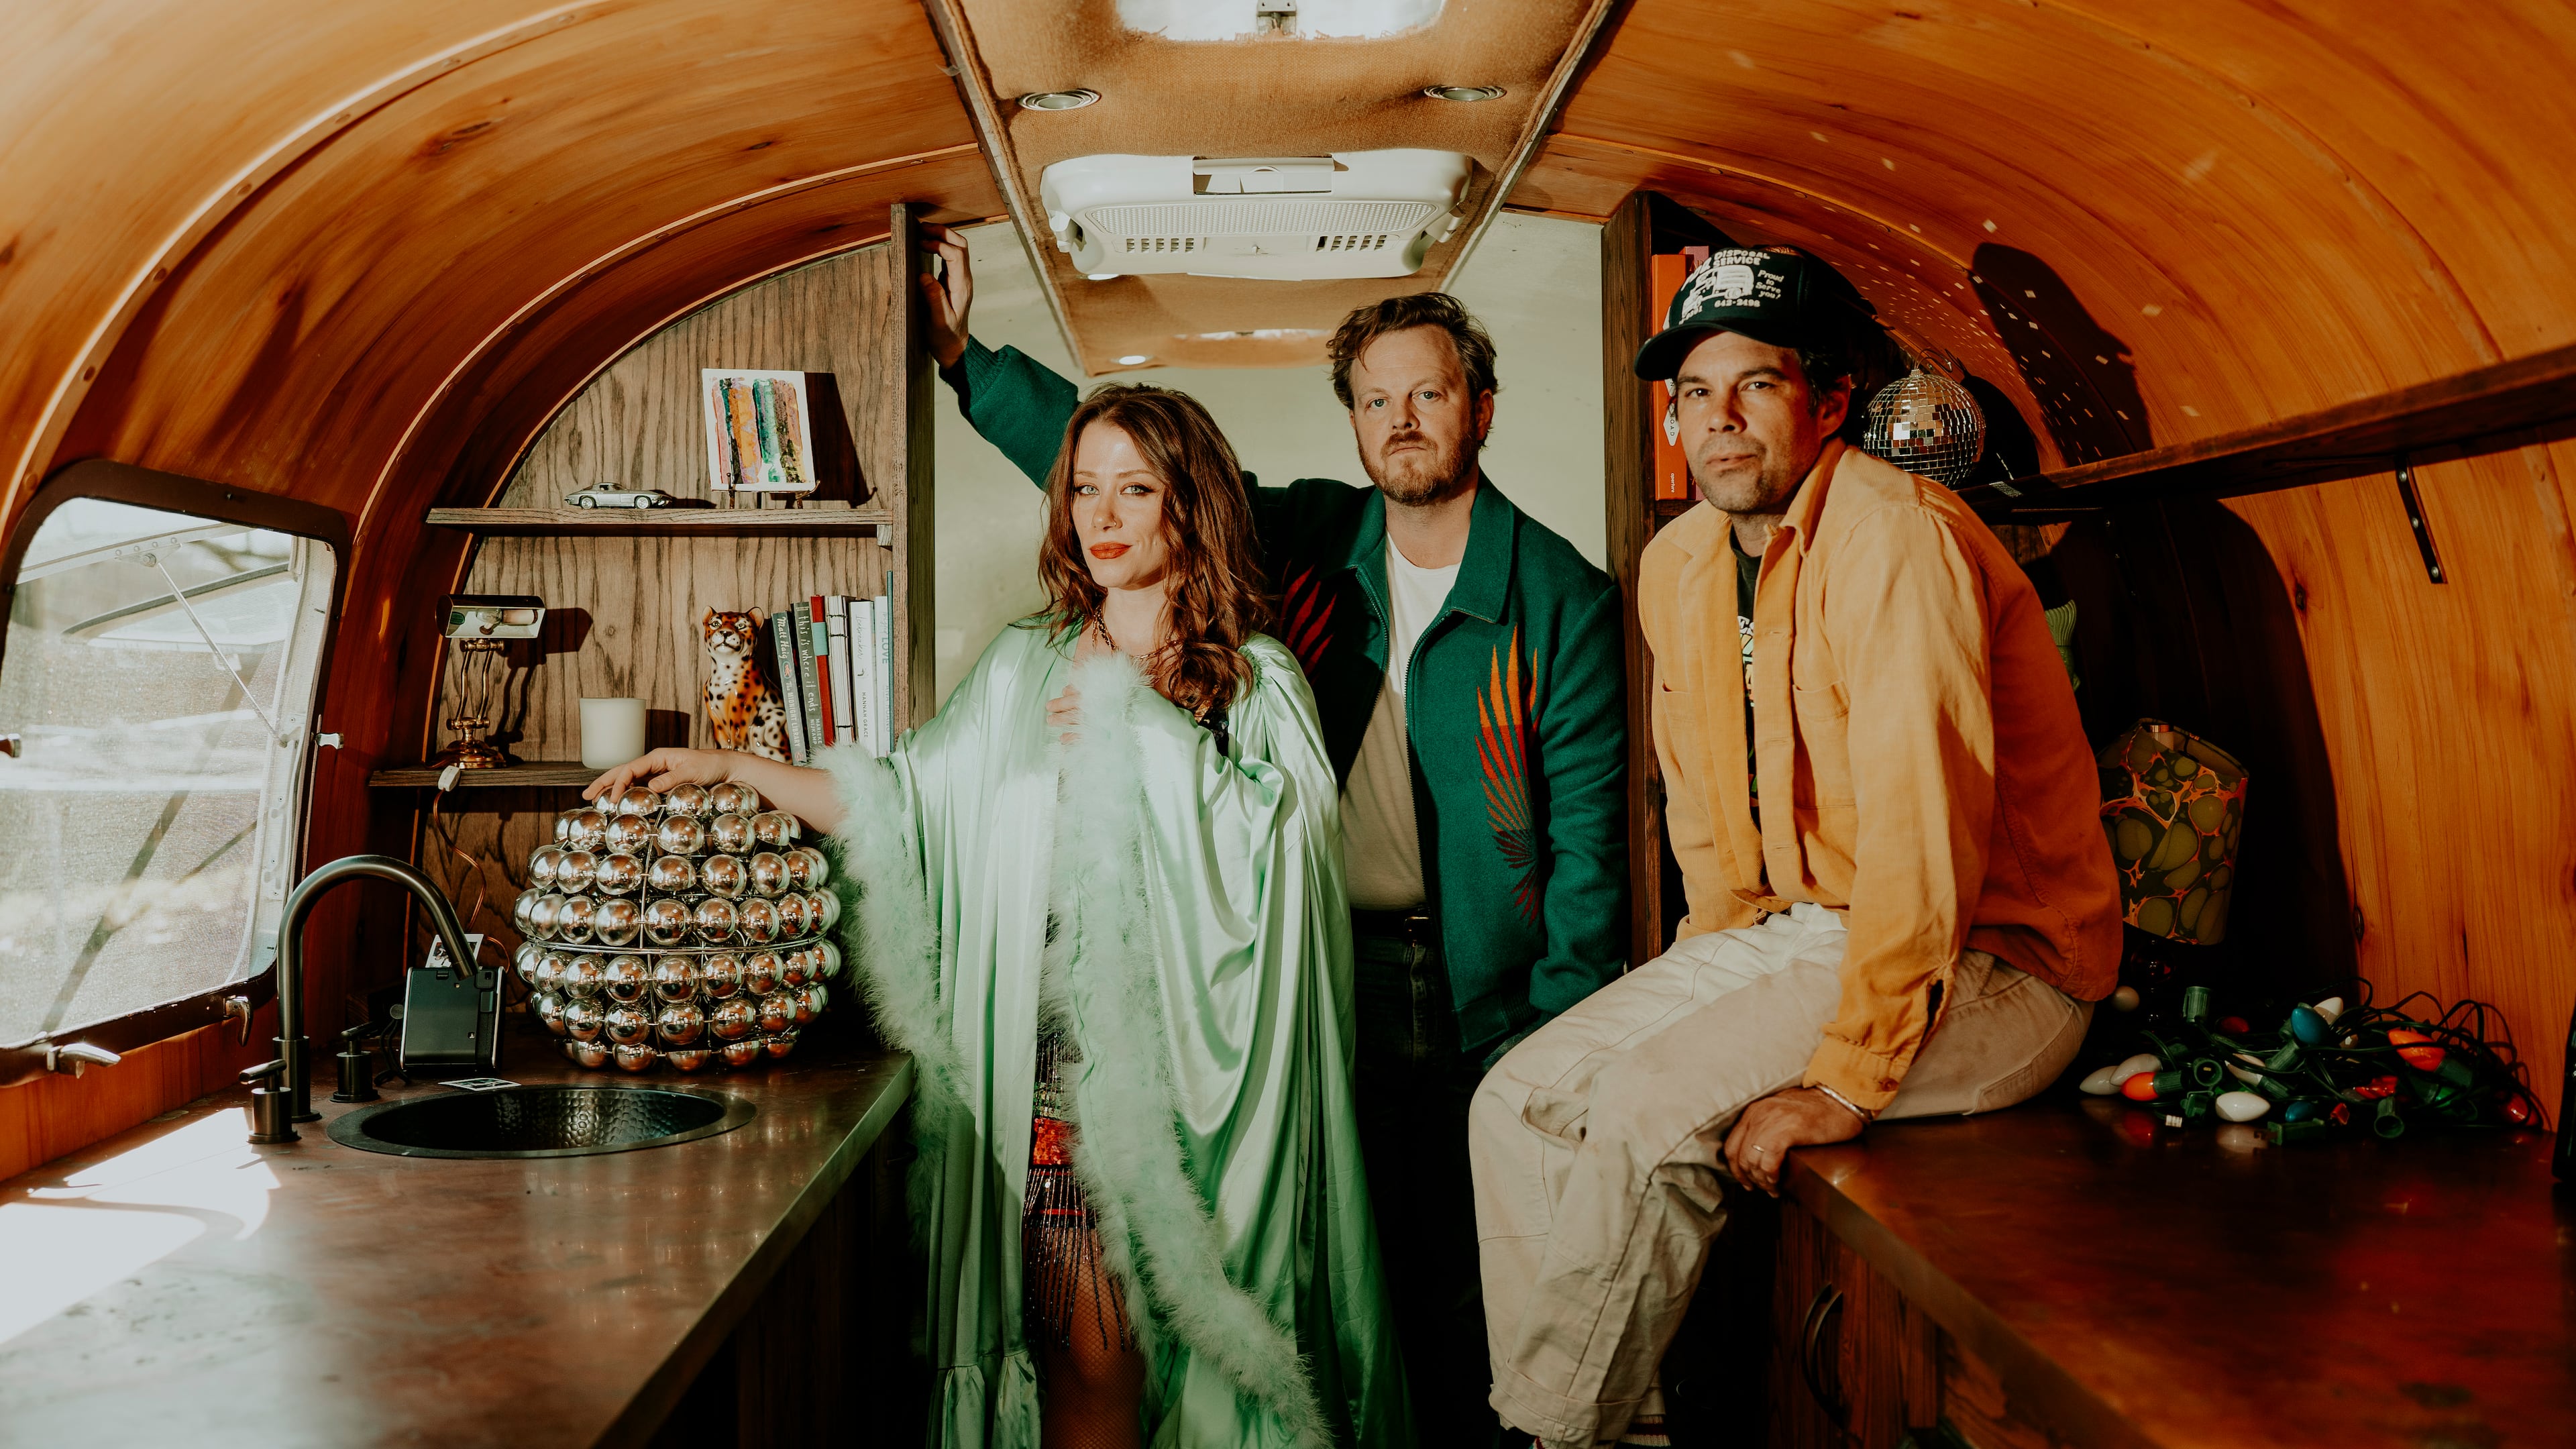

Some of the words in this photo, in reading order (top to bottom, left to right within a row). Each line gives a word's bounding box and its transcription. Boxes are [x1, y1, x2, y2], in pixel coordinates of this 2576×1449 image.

[1713, 256, 1762, 268] SERVICE
[1714, 250, 1770, 260] DISPOSAL
[1758, 270, 1784, 282] Proud
[1756, 281, 1781, 293] Serve
[777, 616, 788, 639] Matt
[798, 616, 810, 635] this
[855, 614, 867, 660] Icebreaker
[778, 641, 790, 659] Haig
[802, 649, 812, 678] where
[808, 692, 818, 712] ends
[788, 692, 796, 720] MIDNIGHT
[792, 722, 800, 747] LIBRARY
